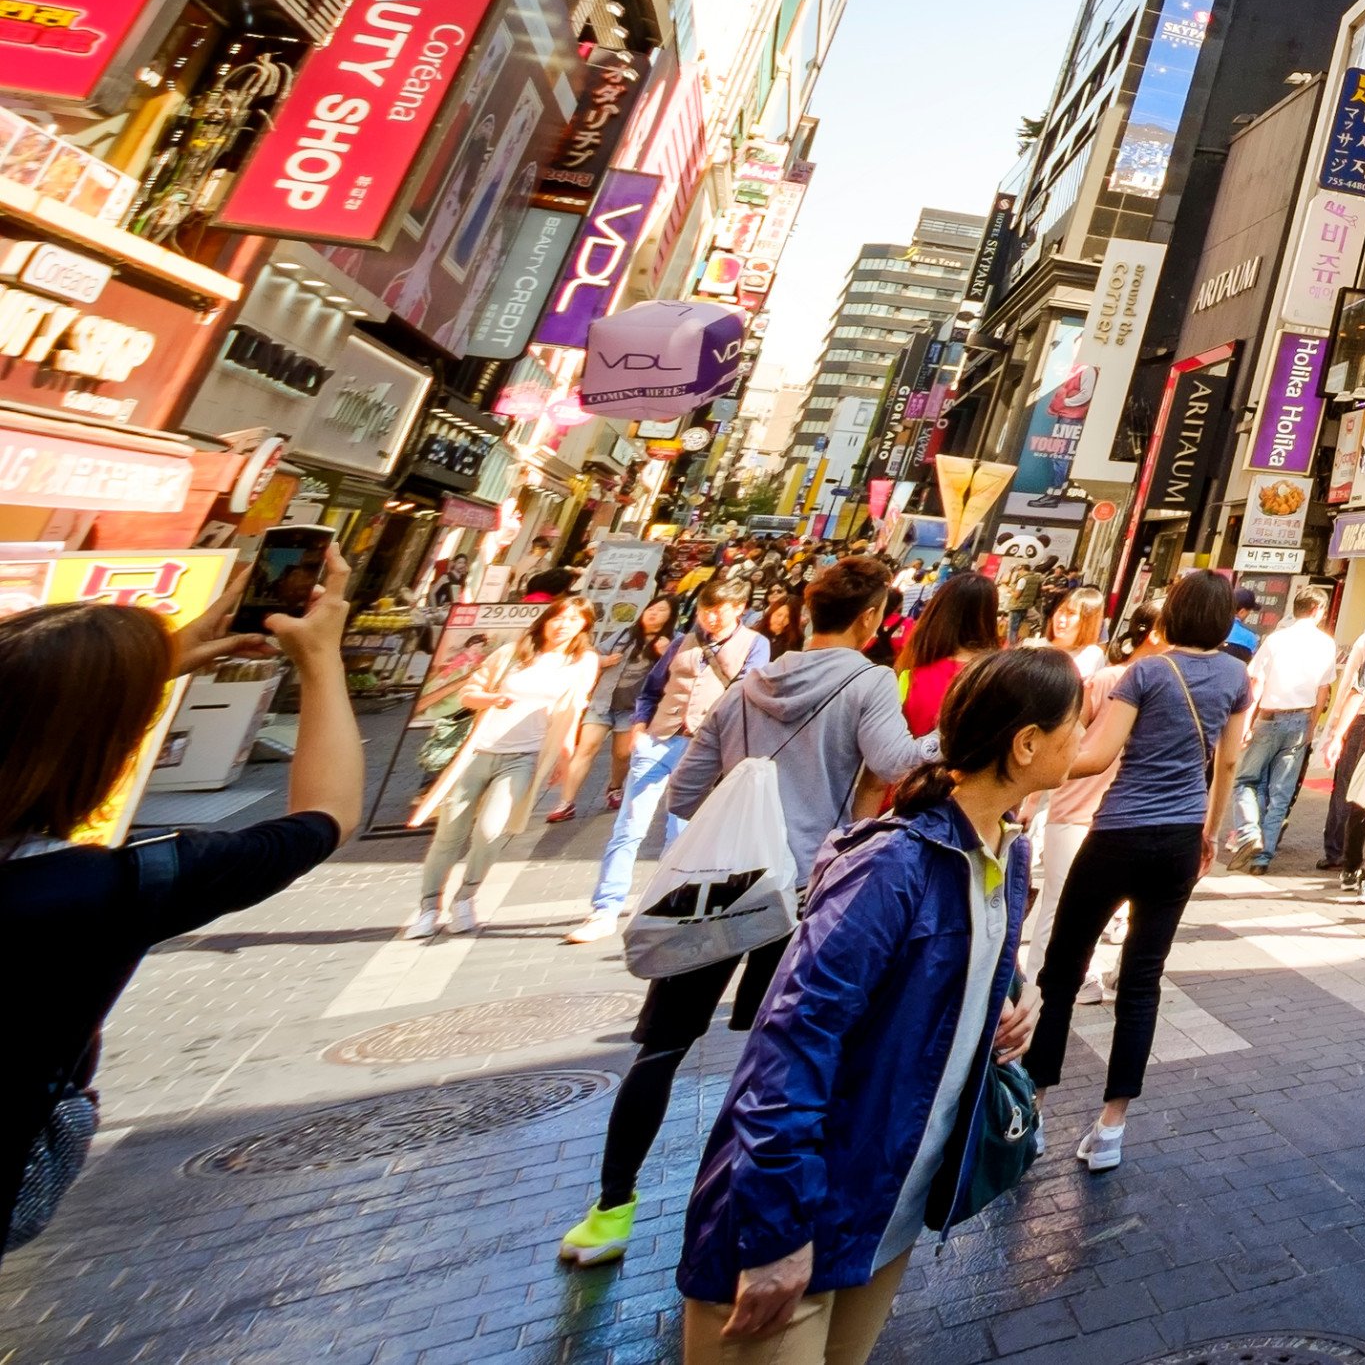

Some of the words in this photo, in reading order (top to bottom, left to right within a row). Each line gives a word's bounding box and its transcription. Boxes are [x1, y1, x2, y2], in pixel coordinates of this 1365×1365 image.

[387, 24, 467, 124] Coréana
[275, 93, 372, 211] SHOP
[1330, 106, 1360, 174] マッサージ
[527, 216, 561, 275] BEAUTY
[990, 212, 1005, 239] HOTEL
[1311, 222, 1350, 285] 비쥬
[556, 203, 644, 314] VDL
[969, 239, 998, 297] SKYPARK
[1193, 256, 1262, 314] ARITAUM
[494, 276, 539, 348] CREDIT
[1123, 263, 1146, 317] around
[598, 350, 683, 372] VDL
[1114, 319, 1134, 346] the
[587, 387, 645, 404] COMING
[645, 385, 686, 399] HERE!
[1285, 337, 1320, 399] Holika
[1029, 435, 1068, 452] YOUR
[1053, 423, 1081, 439] LIVE
[1164, 380, 1213, 504] ARITAUM
[1268, 405, 1304, 468] Holika
